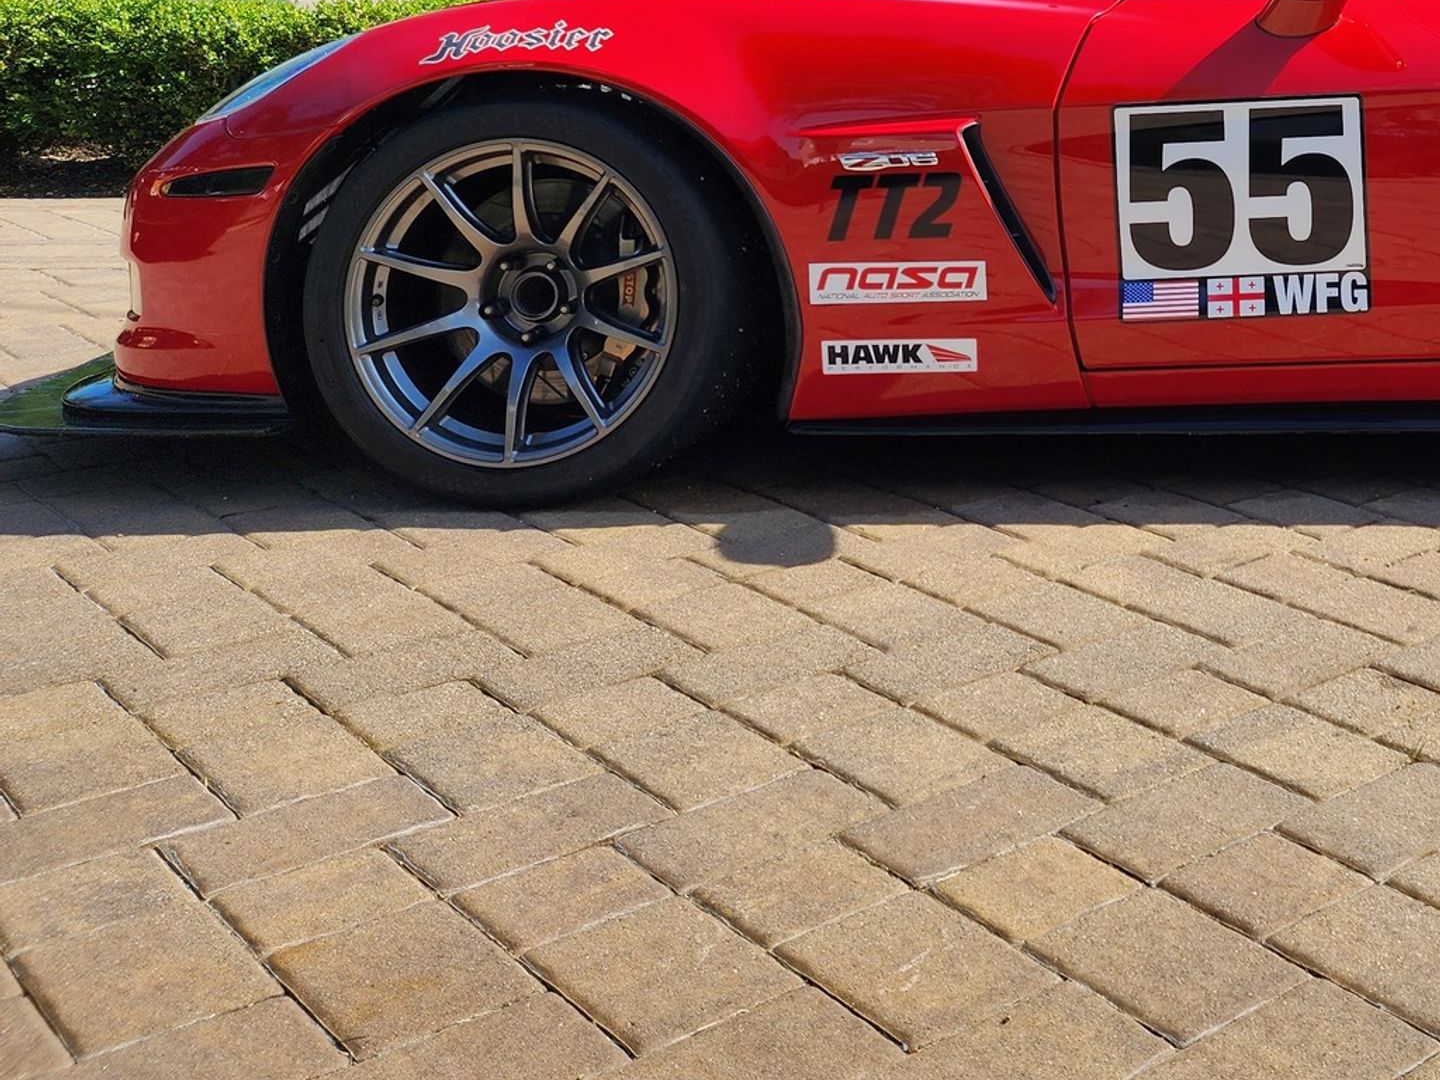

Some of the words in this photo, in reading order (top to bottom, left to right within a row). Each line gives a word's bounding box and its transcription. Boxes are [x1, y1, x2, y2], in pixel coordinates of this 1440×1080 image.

[418, 19, 615, 65] Hoosier
[838, 151, 939, 171] Z06
[827, 172, 962, 242] TT2
[1128, 104, 1355, 271] 55
[890, 291, 920, 299] SPORT
[921, 290, 980, 298] ASSOCIATION
[1273, 271, 1368, 315] WFG
[827, 344, 923, 365] HAWK
